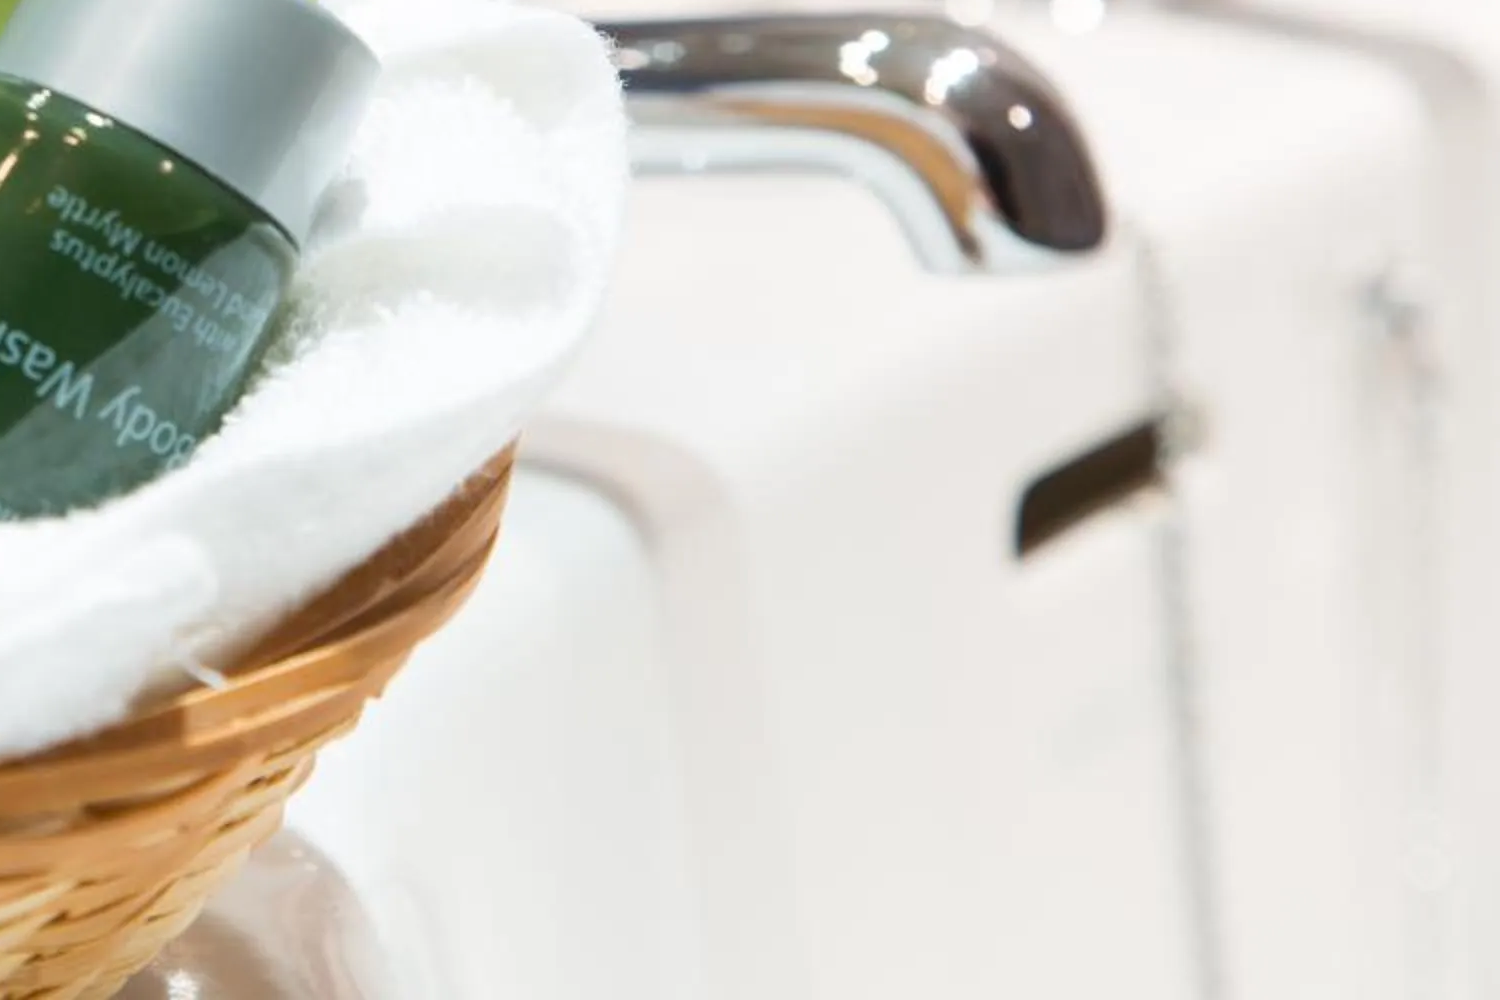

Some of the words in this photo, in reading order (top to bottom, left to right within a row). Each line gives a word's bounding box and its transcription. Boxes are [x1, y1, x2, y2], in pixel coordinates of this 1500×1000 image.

[47, 185, 142, 257] Myrtle
[50, 229, 195, 332] Eucalyptus
[98, 385, 196, 471] Body
